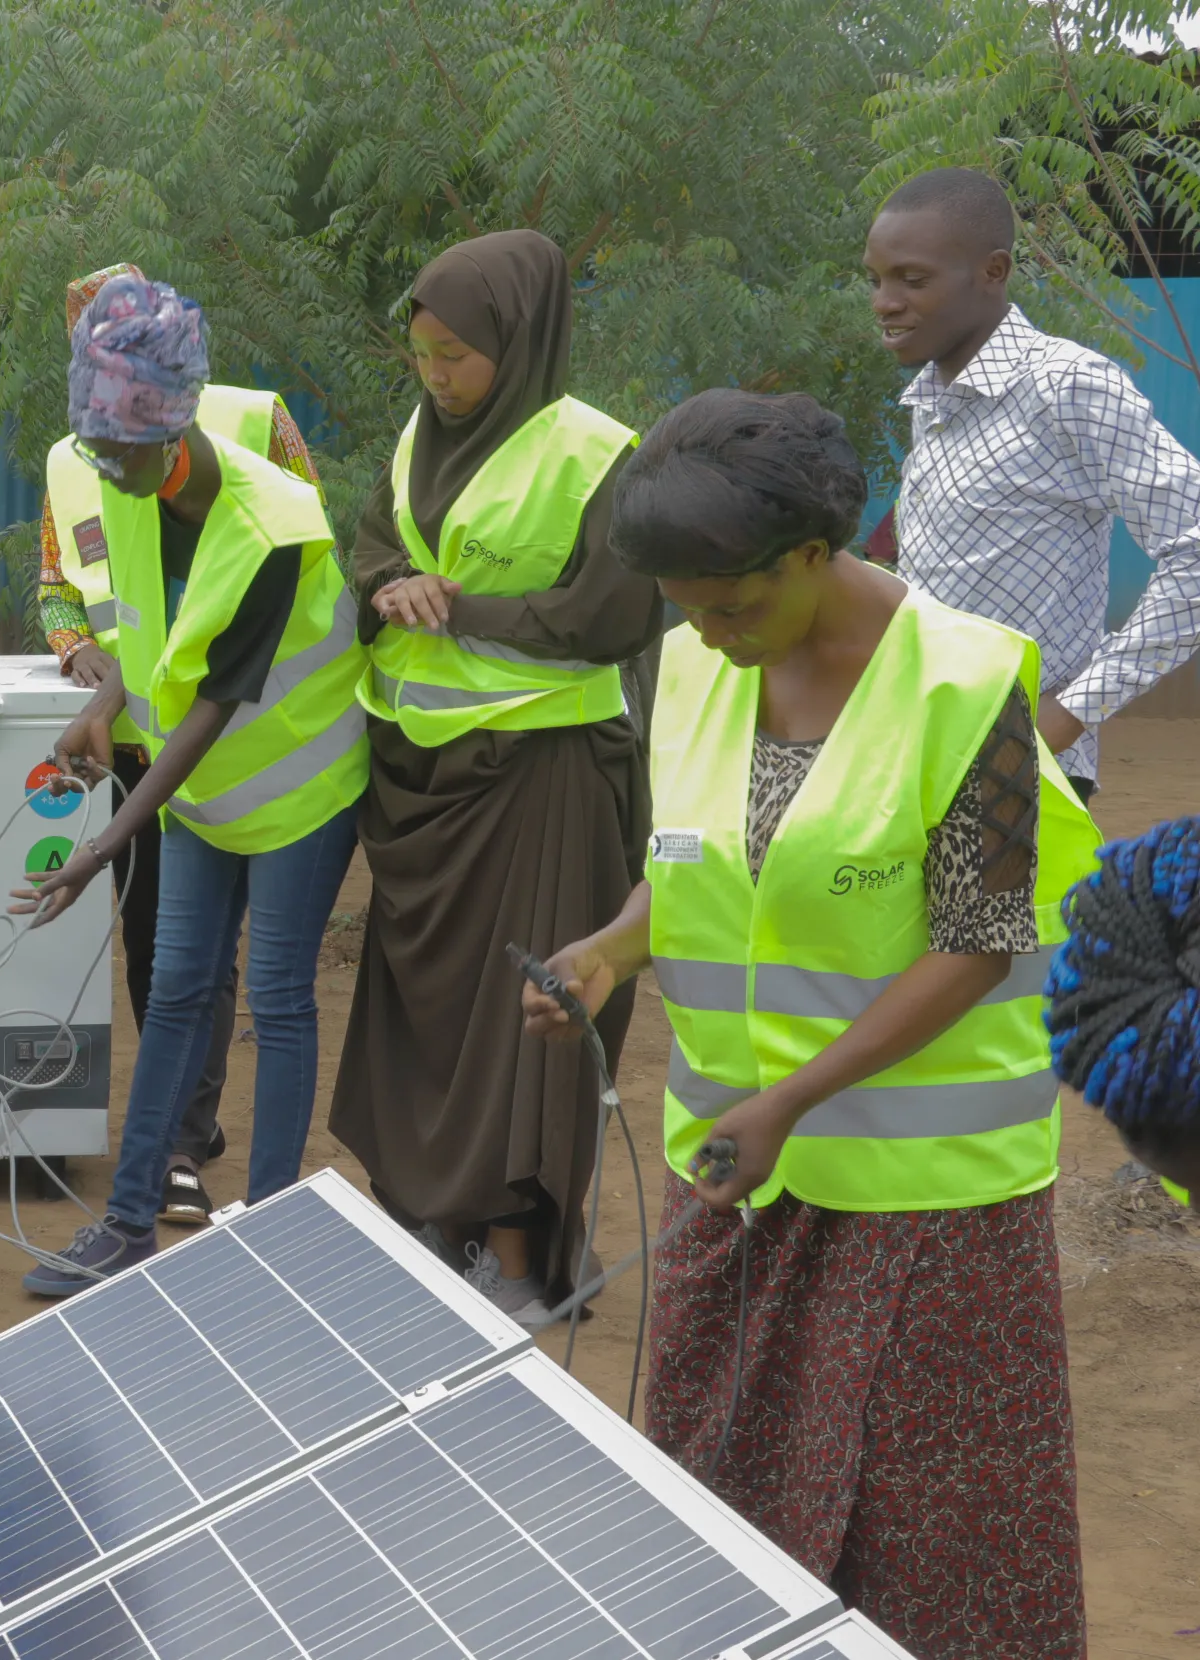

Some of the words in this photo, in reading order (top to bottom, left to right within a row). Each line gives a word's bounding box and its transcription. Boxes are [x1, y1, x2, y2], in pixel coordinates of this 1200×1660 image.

[476, 554, 510, 572] FREEZE
[479, 546, 513, 567] SOLAR
[44, 850, 65, 873] A
[858, 861, 904, 882] SOLAR
[859, 871, 905, 891] FREEZE
